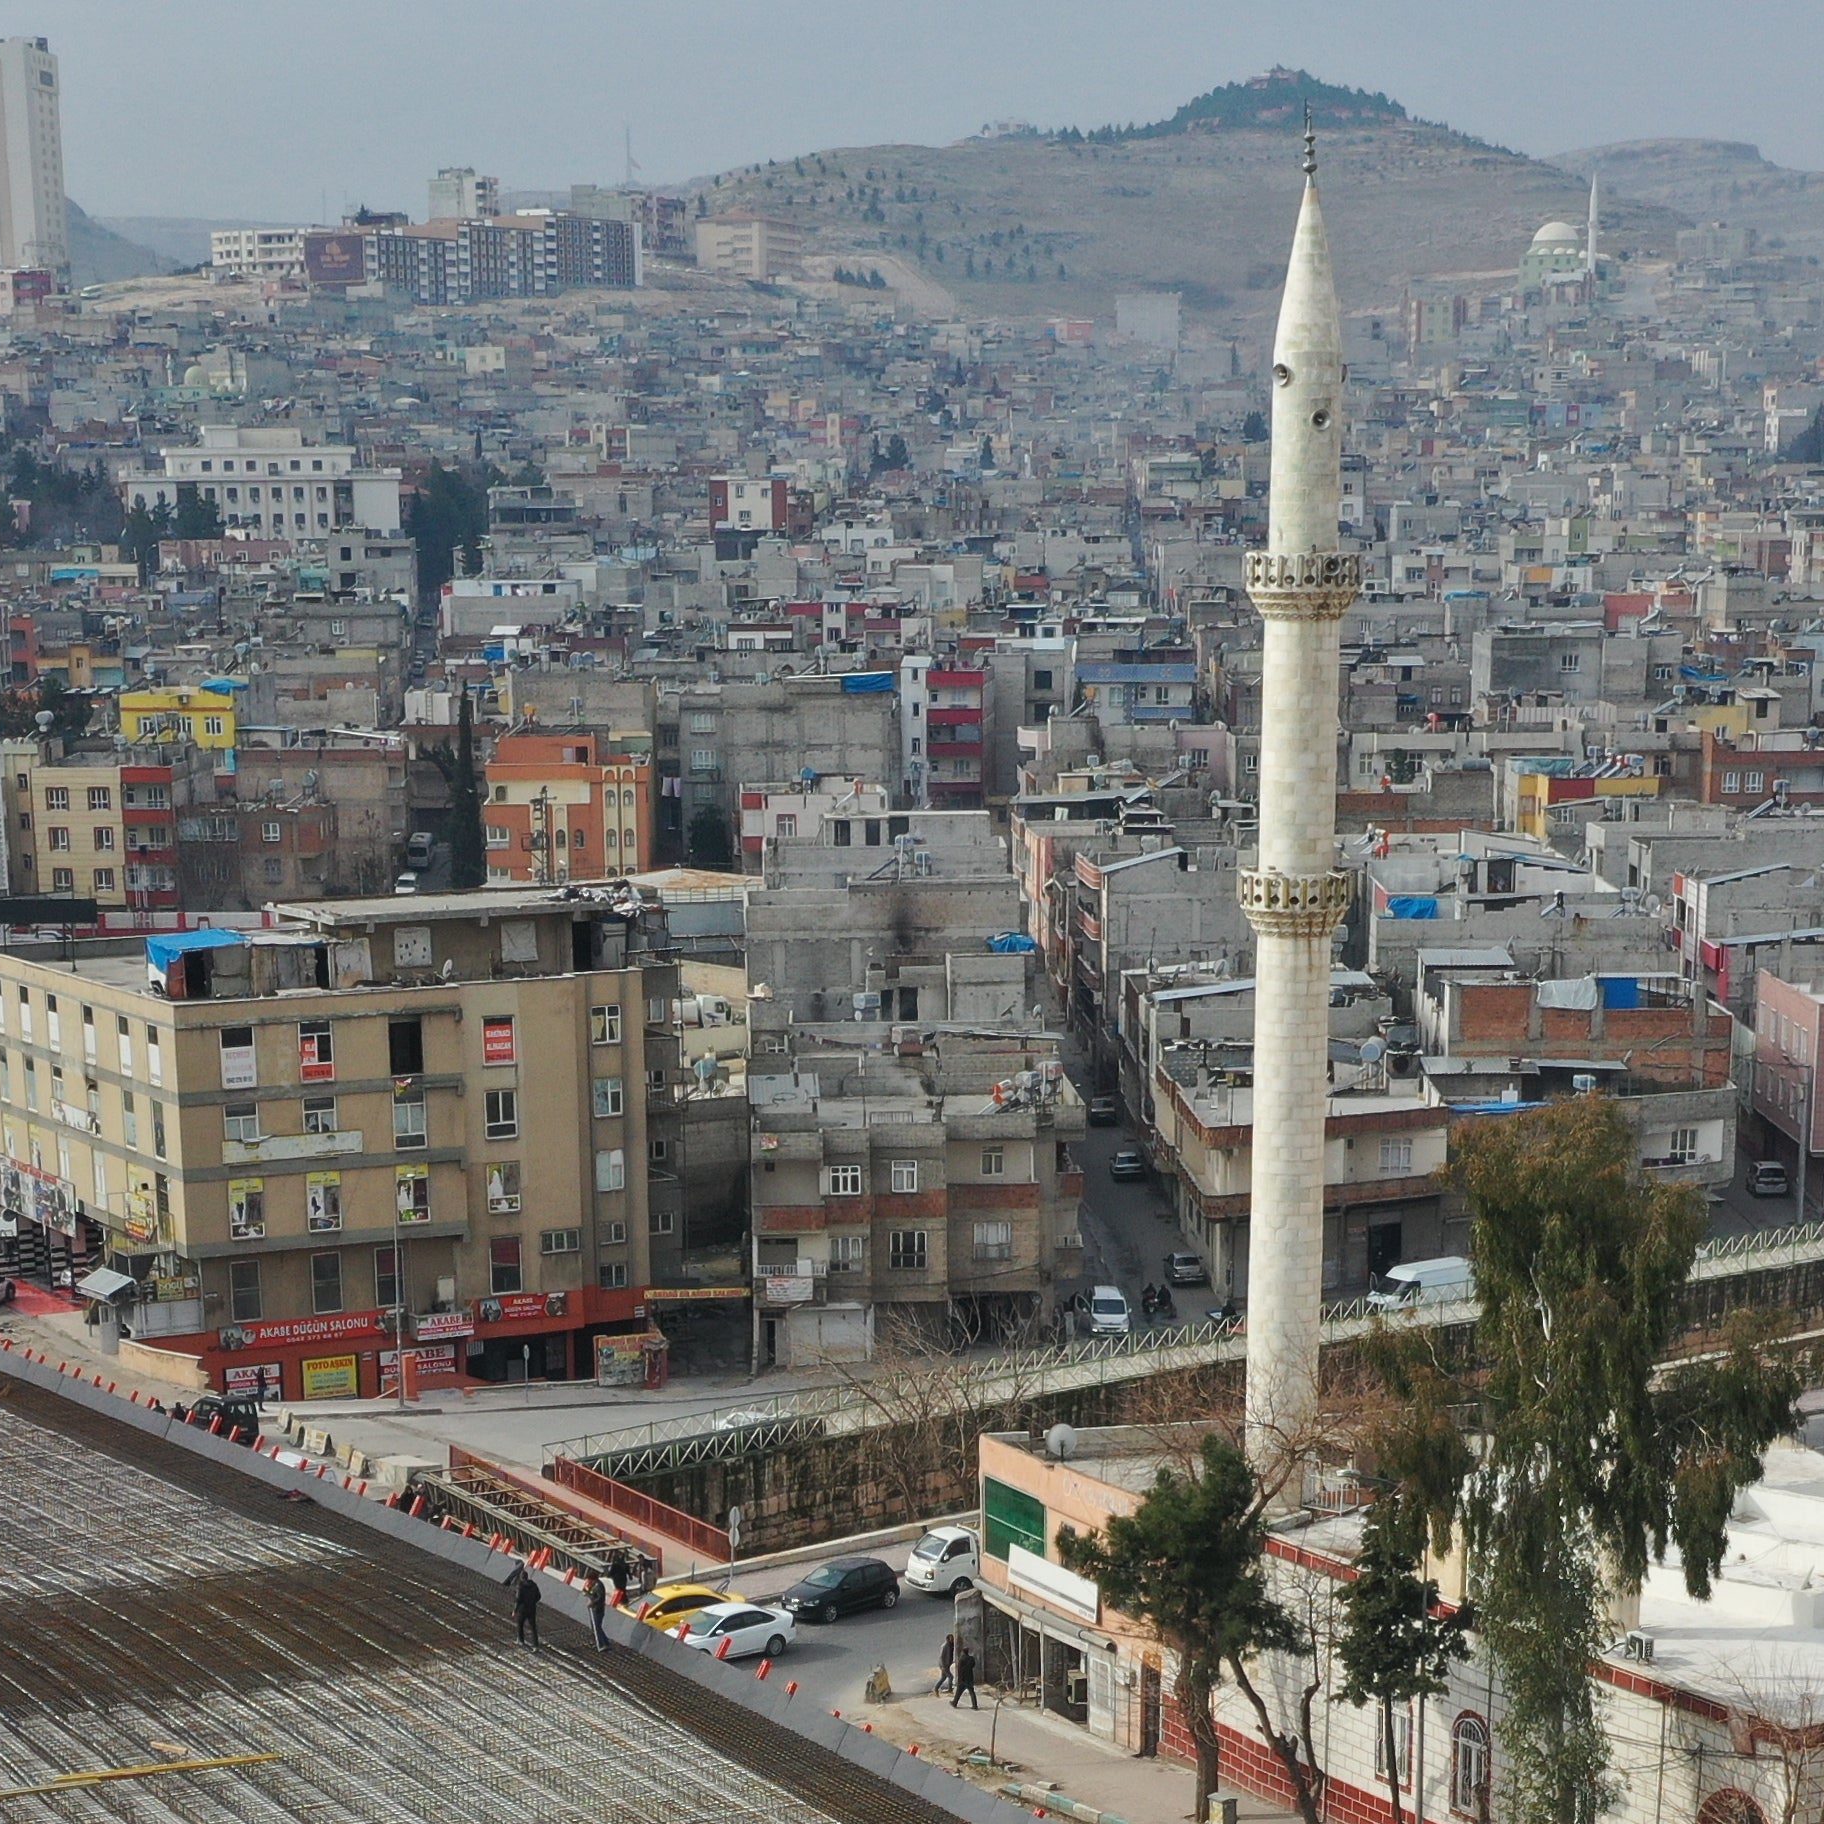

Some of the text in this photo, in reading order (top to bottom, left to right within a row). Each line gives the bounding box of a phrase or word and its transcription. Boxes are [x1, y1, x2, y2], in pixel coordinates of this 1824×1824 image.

[430, 1315, 462, 1327] AKABE
[260, 1317, 368, 1339] AKABE DÜĞÜN SALONU
[390, 1349, 446, 1363] AABE
[307, 1361, 329, 1370] FOTO
[417, 1360, 453, 1370] SALONU
[233, 1367, 273, 1379] AKAE
